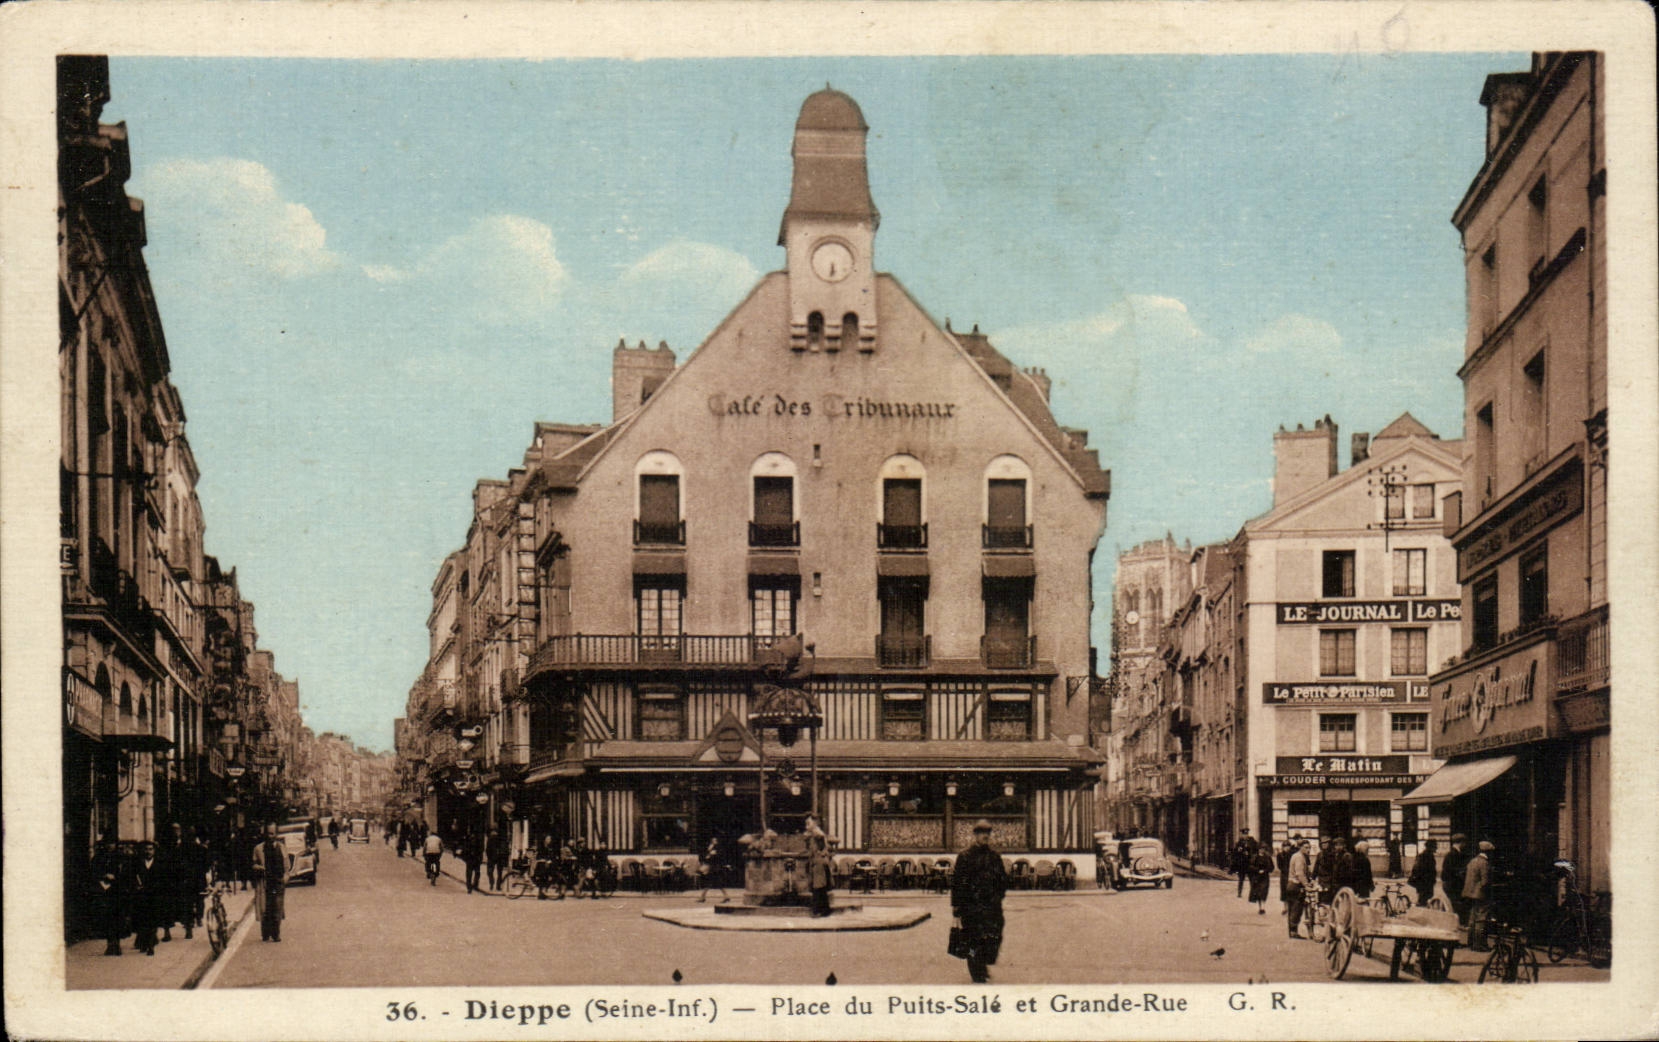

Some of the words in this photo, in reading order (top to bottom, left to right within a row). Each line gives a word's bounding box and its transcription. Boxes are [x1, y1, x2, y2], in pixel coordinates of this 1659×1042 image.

[774, 393, 812, 416] des
[820, 392, 956, 418] Tribunaux
[1283, 606, 1308, 621] LE
[1316, 604, 1401, 620] JOURNAL
[1416, 603, 1437, 619] Le
[1440, 602, 1462, 619] Pe
[1273, 687, 1290, 699] Le
[1292, 685, 1325, 699] Petit
[1339, 685, 1396, 699] Parisien
[1301, 757, 1324, 773] Le
[1329, 757, 1383, 773] Matin
[1282, 775, 1327, 785] COUDER
[1329, 776, 1395, 785] CORRESPONDANT
[1396, 776, 1413, 785] DES
